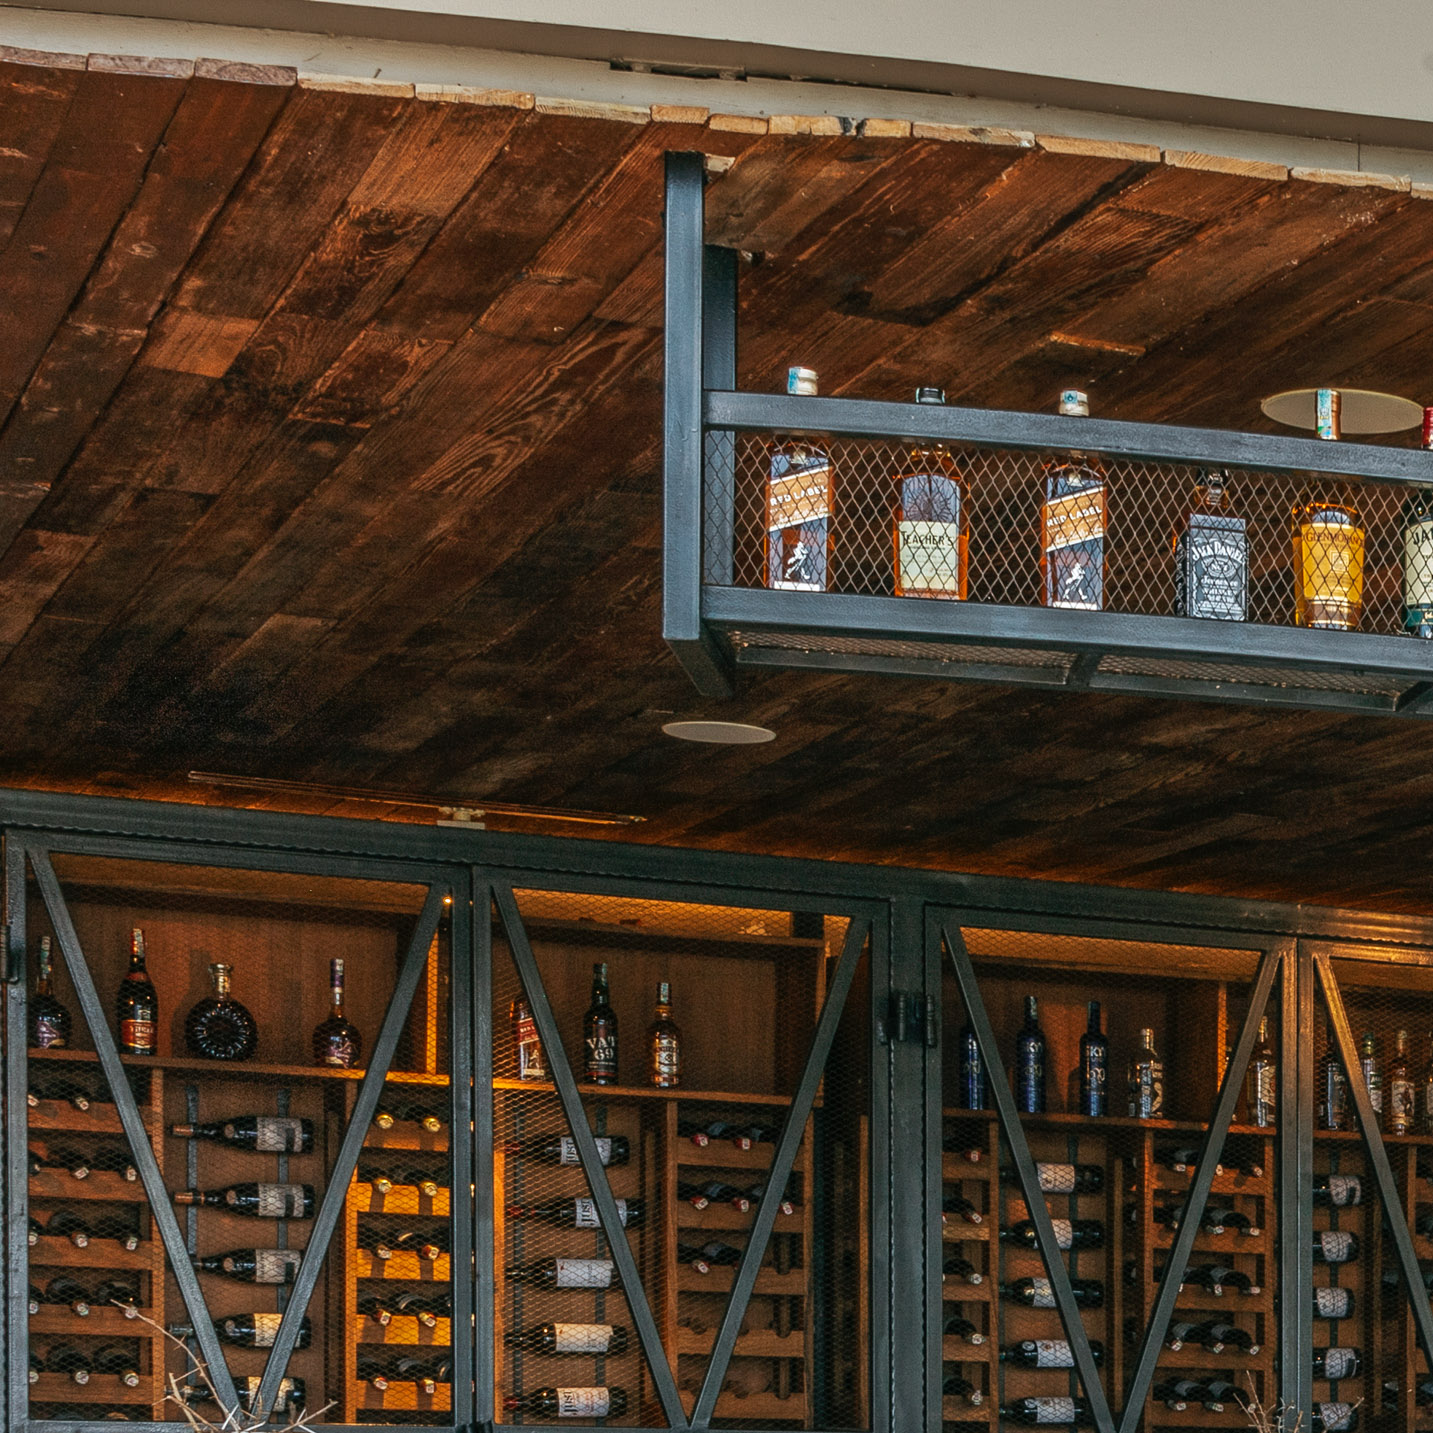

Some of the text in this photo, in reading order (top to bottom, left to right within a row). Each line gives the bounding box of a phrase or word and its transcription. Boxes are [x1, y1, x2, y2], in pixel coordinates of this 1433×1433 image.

[770, 485, 828, 507] RED LABEL
[1046, 506, 1103, 528] RED LABEL
[901, 531, 955, 547] TEACHER'S
